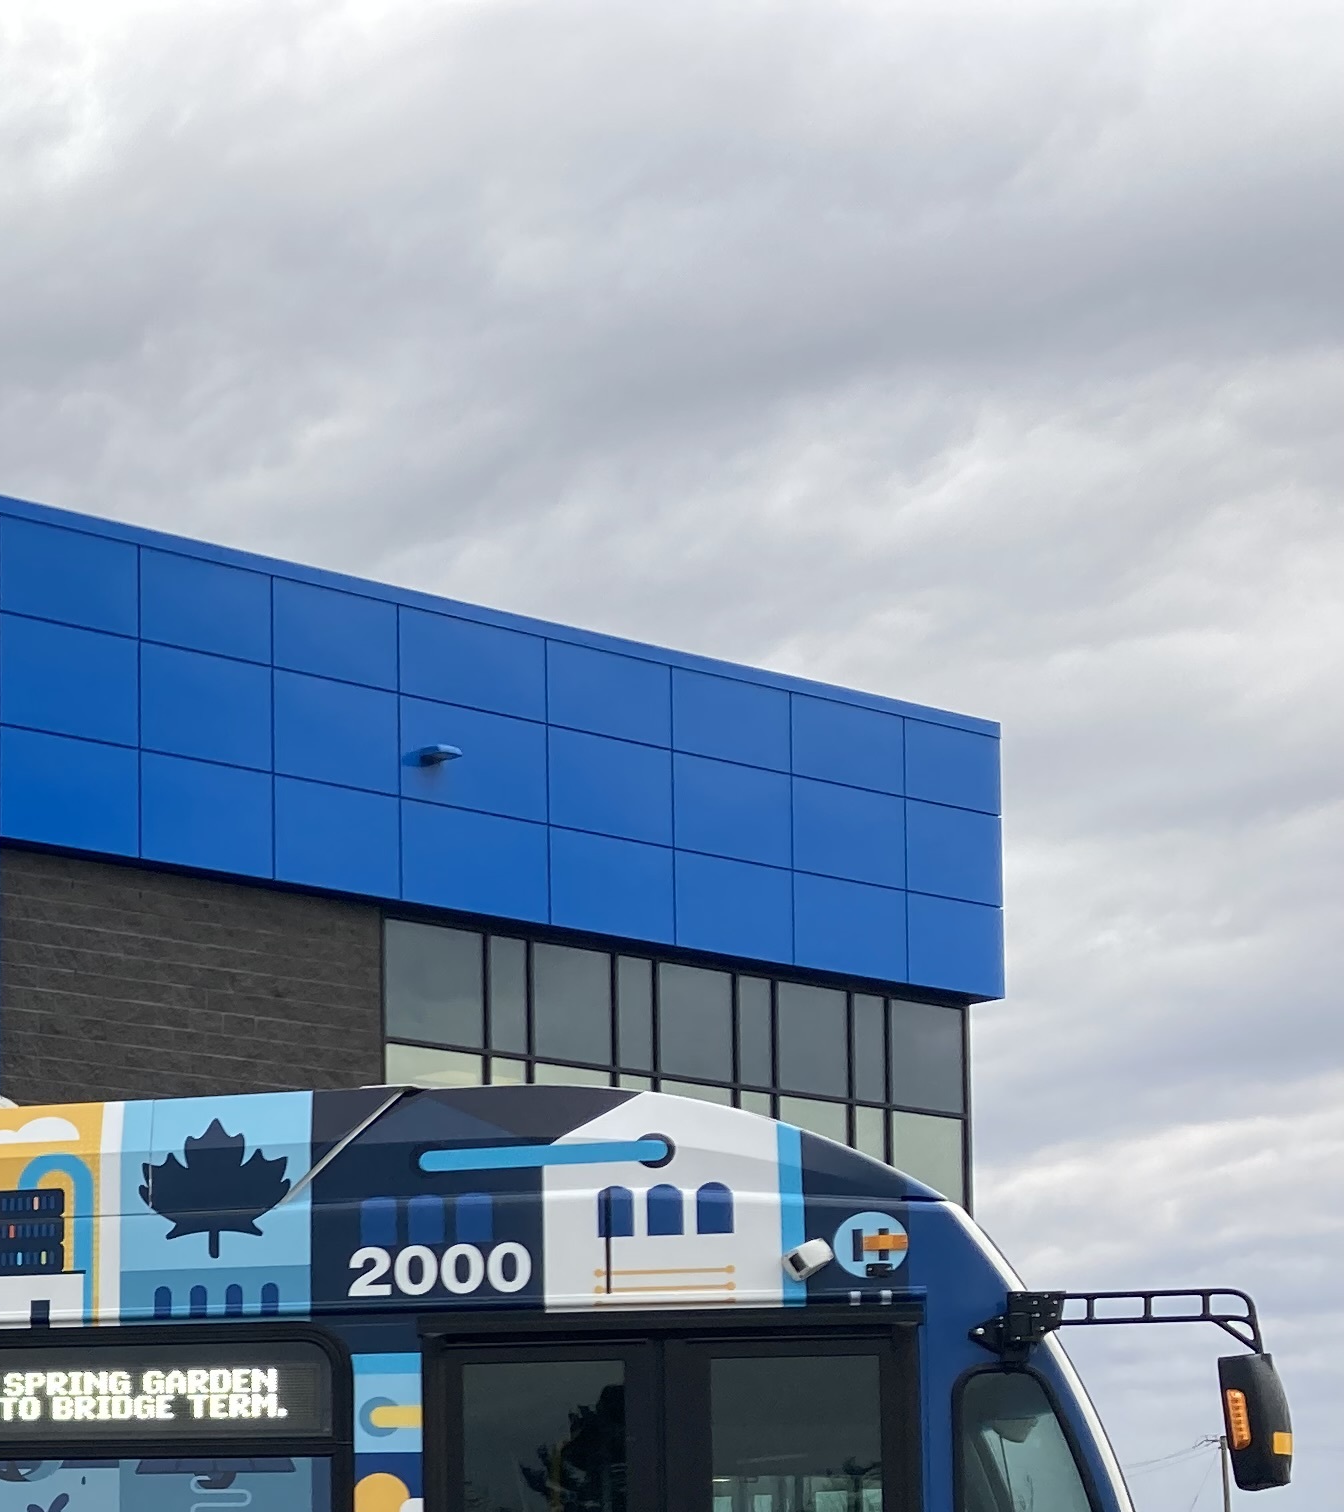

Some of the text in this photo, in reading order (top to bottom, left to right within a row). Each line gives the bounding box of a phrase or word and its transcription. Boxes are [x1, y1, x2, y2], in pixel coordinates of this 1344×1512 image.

[347, 1241, 532, 1297] 2000
[2, 1368, 279, 1397] SPRING GARDEN
[51, 1395, 175, 1421] BRIDGE
[186, 1393, 289, 1420] TERM.
